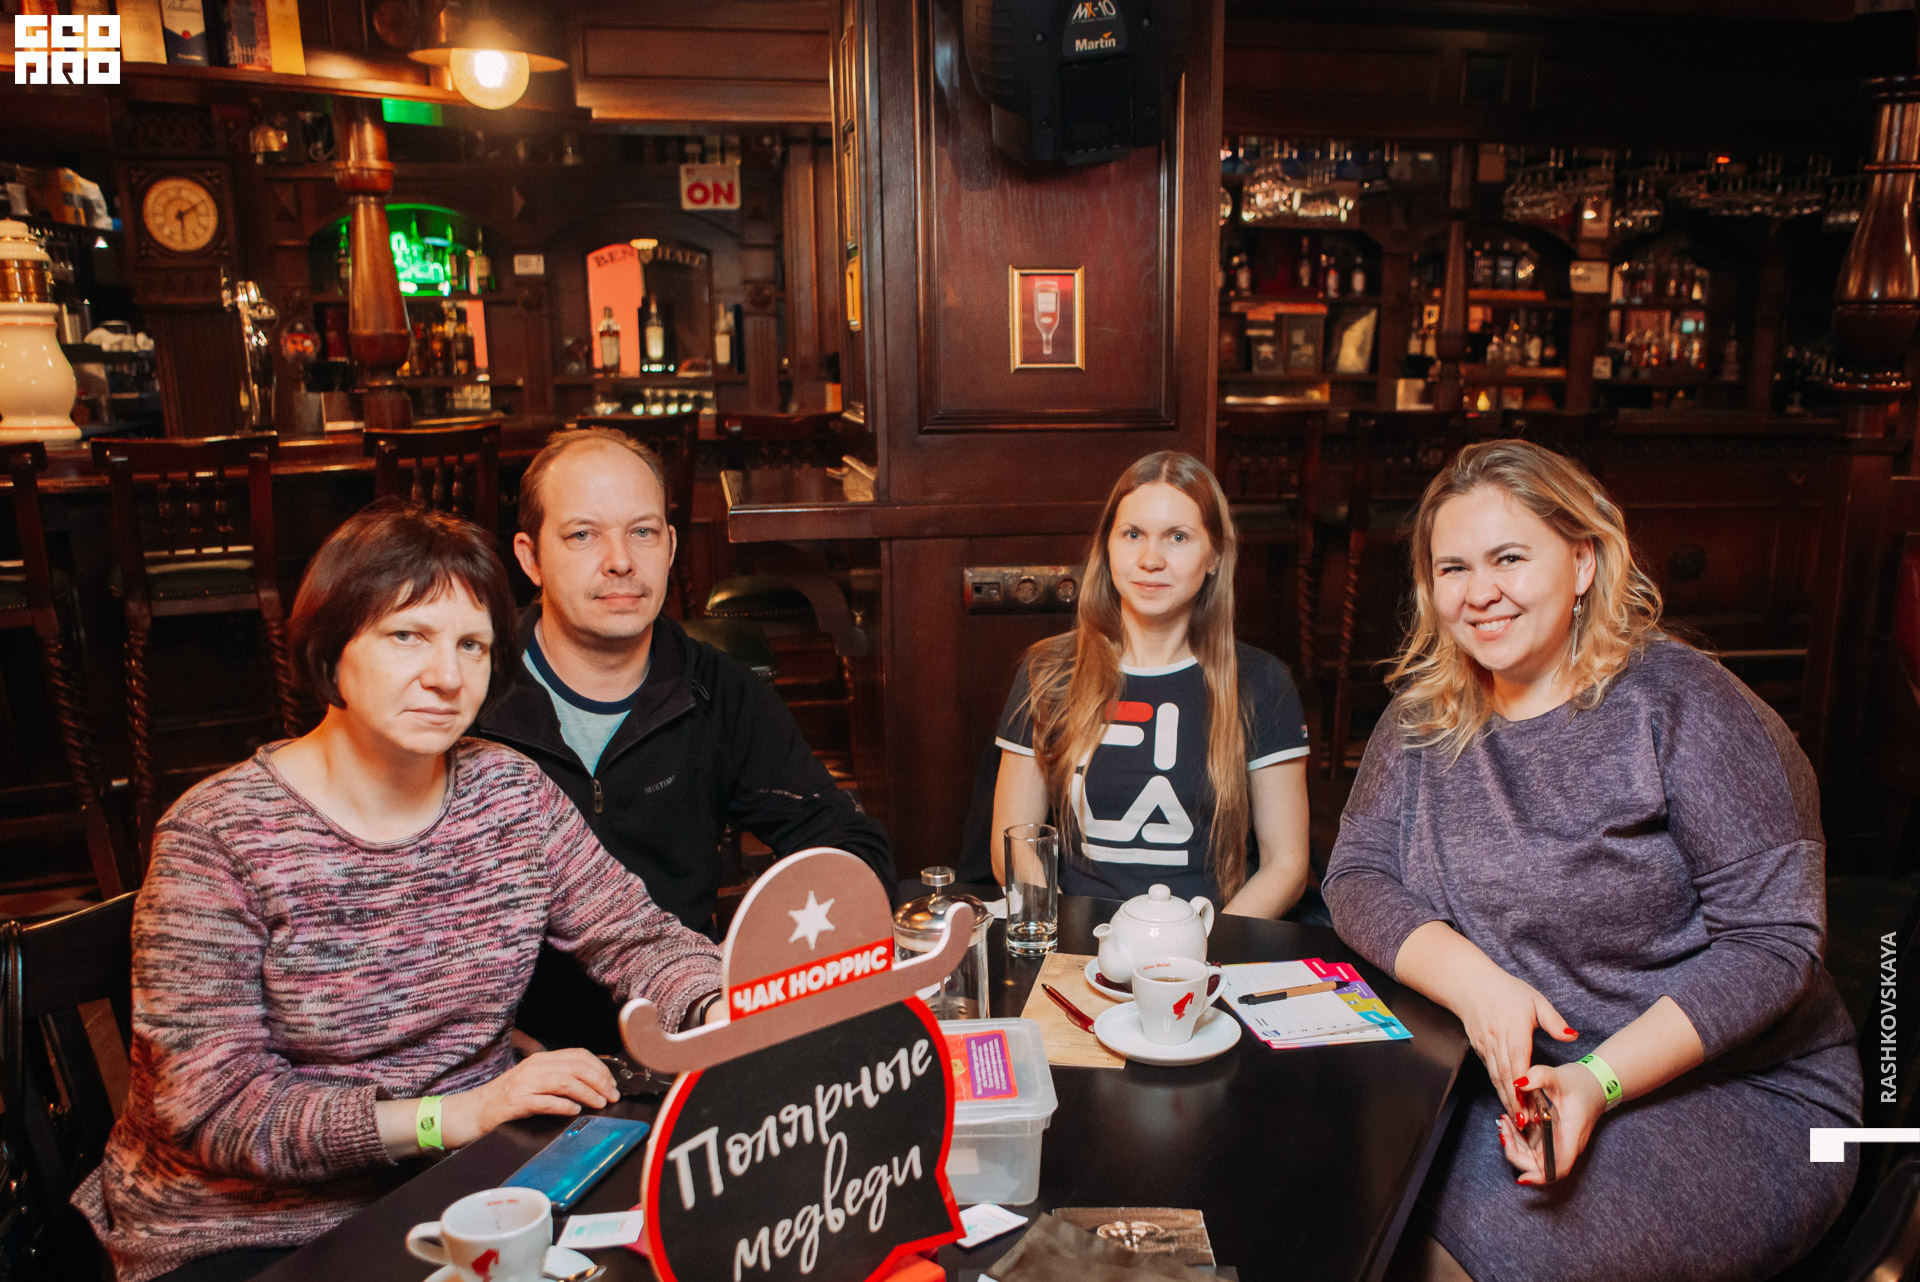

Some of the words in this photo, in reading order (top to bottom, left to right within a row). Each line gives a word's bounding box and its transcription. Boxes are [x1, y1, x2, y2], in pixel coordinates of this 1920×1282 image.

[1075, 37, 1116, 52] Martin
[687, 181, 735, 205] ON
[733, 977, 787, 1013] ЧАК
[789, 945, 888, 998] НОРРИС
[666, 1038, 933, 1211] Полярные
[733, 1132, 923, 1282] медведи
